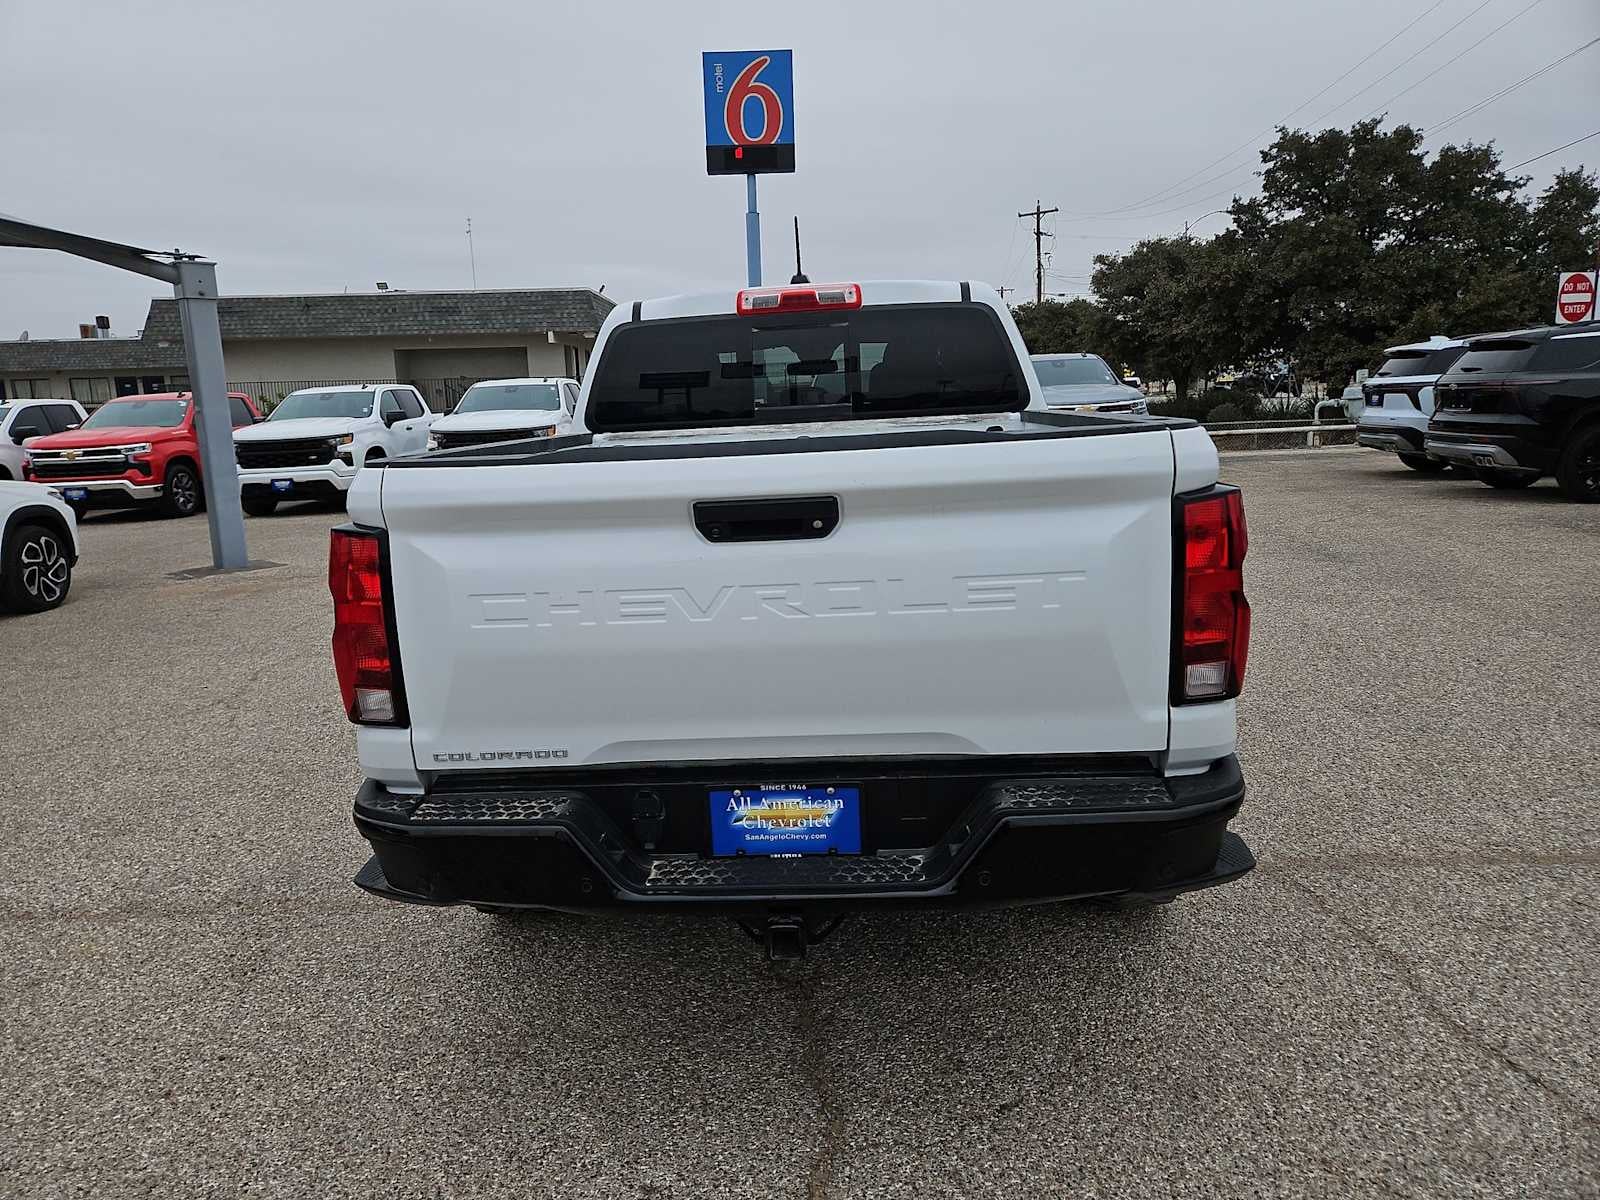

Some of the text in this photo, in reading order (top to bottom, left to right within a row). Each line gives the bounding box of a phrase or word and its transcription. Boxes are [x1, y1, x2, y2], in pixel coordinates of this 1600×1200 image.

[714, 63, 724, 93] motel
[724, 55, 784, 145] 6
[1564, 282, 1590, 291] DO NOT
[1564, 304, 1586, 314] ENTER
[467, 570, 1088, 629] CHEVROLET
[432, 749, 569, 762] COLORADO
[760, 784, 786, 792] SINCE
[726, 796, 844, 812] All American
[743, 814, 832, 830] Chevrolet
[745, 833, 827, 842] SanAngeloChevy.com
